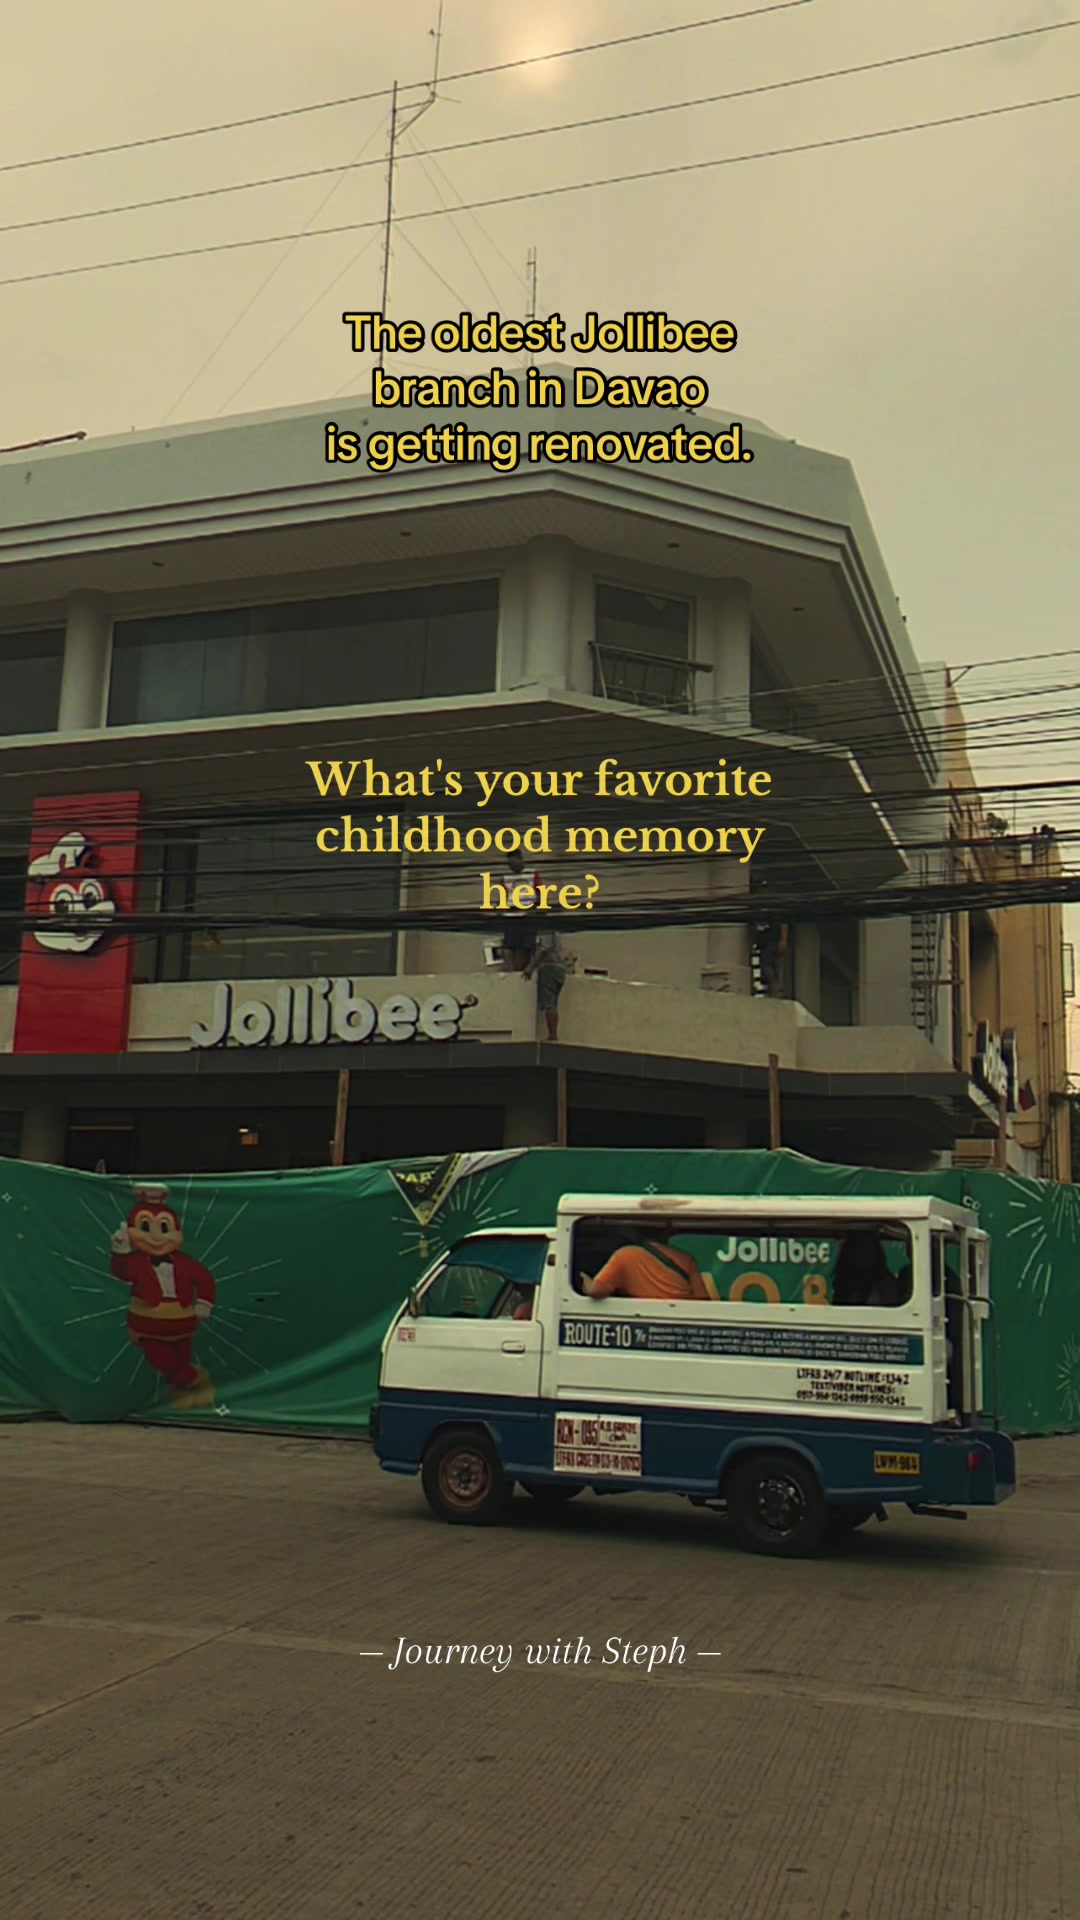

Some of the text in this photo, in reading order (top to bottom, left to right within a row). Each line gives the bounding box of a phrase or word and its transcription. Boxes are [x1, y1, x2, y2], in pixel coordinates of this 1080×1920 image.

[190, 977, 465, 1047] Jollibee
[716, 1236, 830, 1263] Jollibee
[564, 1322, 632, 1347] ROUTE-10
